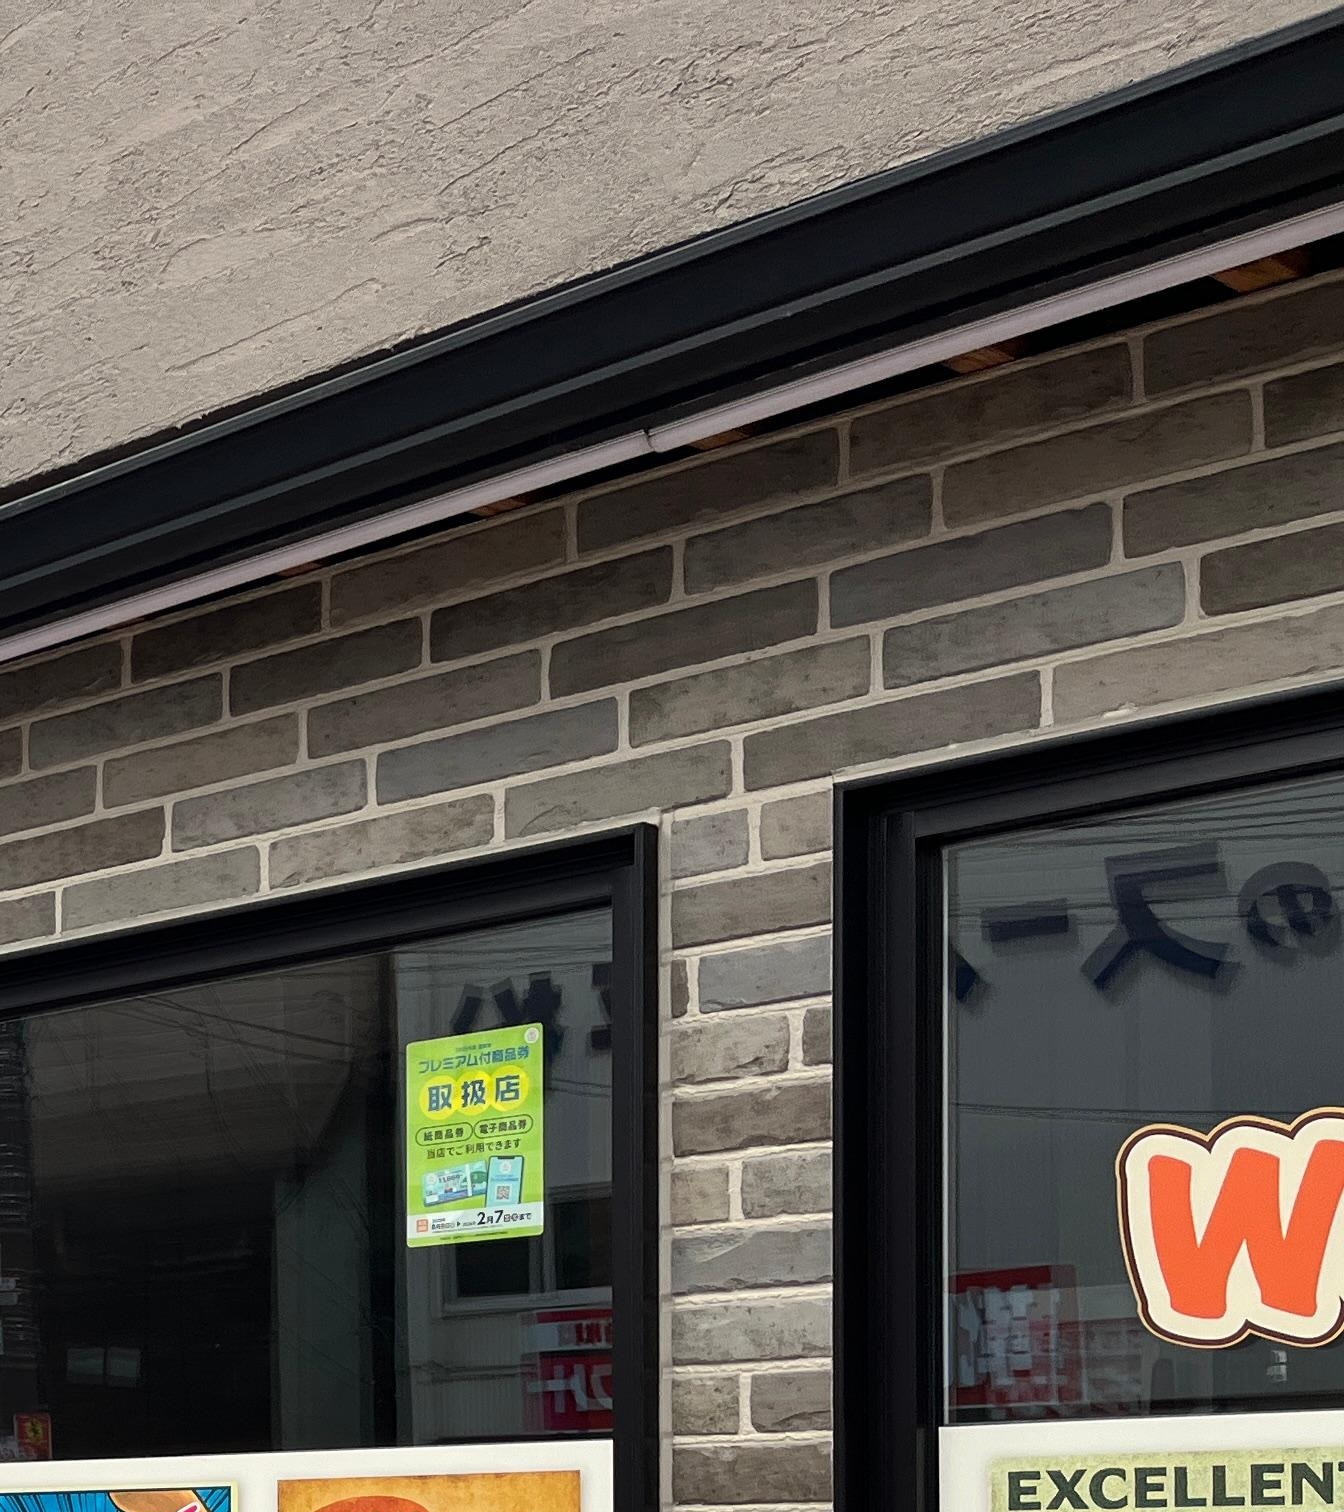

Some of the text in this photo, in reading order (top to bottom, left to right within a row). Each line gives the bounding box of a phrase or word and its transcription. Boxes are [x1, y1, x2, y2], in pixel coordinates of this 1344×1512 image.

[419, 1045, 530, 1074] プレミアム付商品券
[427, 1074, 521, 1112] 取扱店
[1007, 1461, 1344, 1511] EXCELLEN
